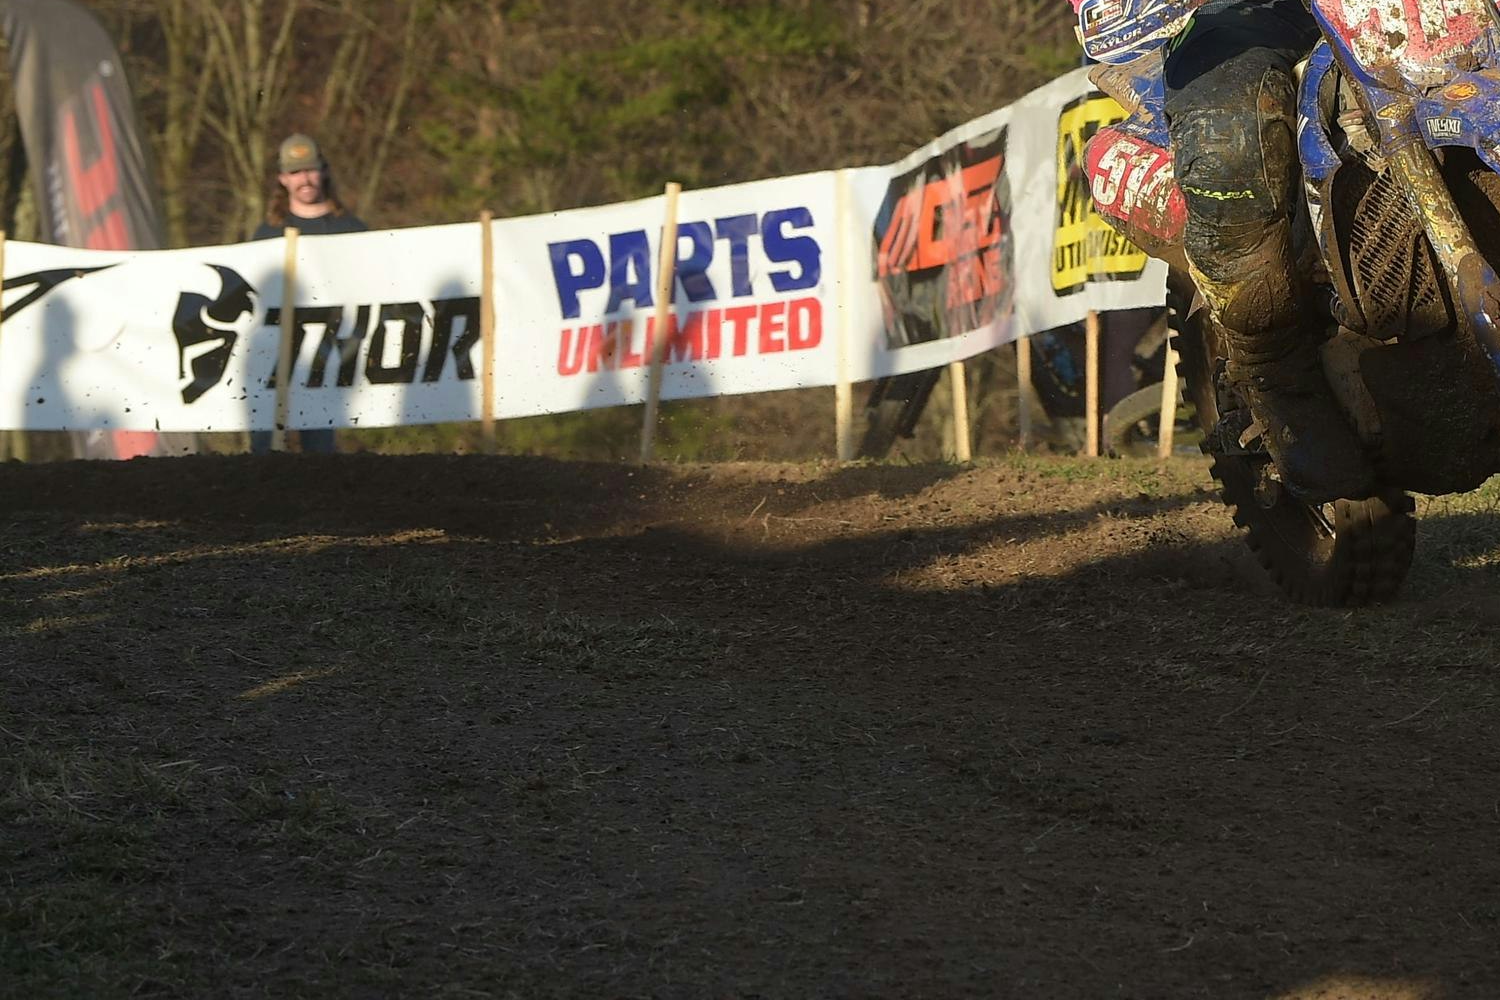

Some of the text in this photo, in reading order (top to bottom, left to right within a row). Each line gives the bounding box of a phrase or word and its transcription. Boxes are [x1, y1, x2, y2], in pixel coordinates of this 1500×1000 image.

[547, 206, 822, 320] PARTS
[263, 296, 481, 390] THOR
[557, 297, 823, 377] UNLIMITED
